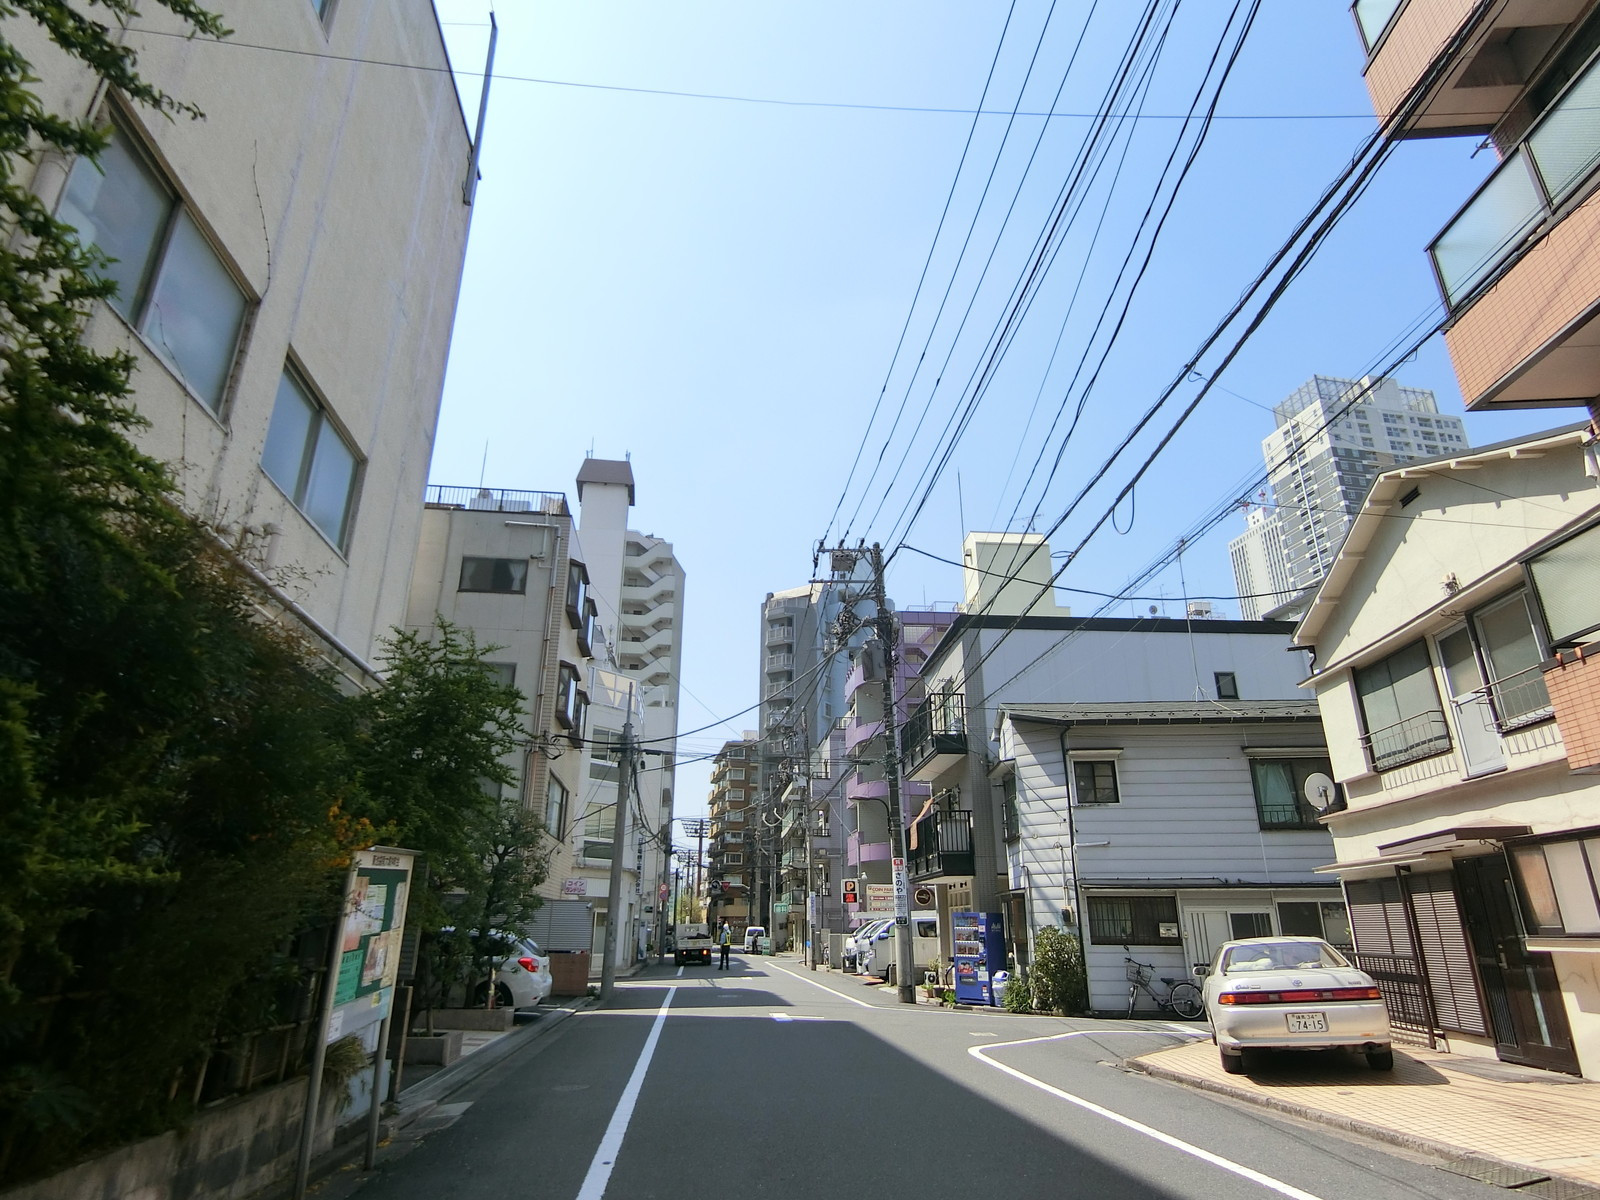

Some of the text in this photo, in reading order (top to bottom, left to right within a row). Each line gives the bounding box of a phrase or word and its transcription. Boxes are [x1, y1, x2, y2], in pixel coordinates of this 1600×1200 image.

[846, 881, 855, 891] P
[895, 872, 903, 894] さのや
[1296, 1020, 1324, 1030] 74-15
